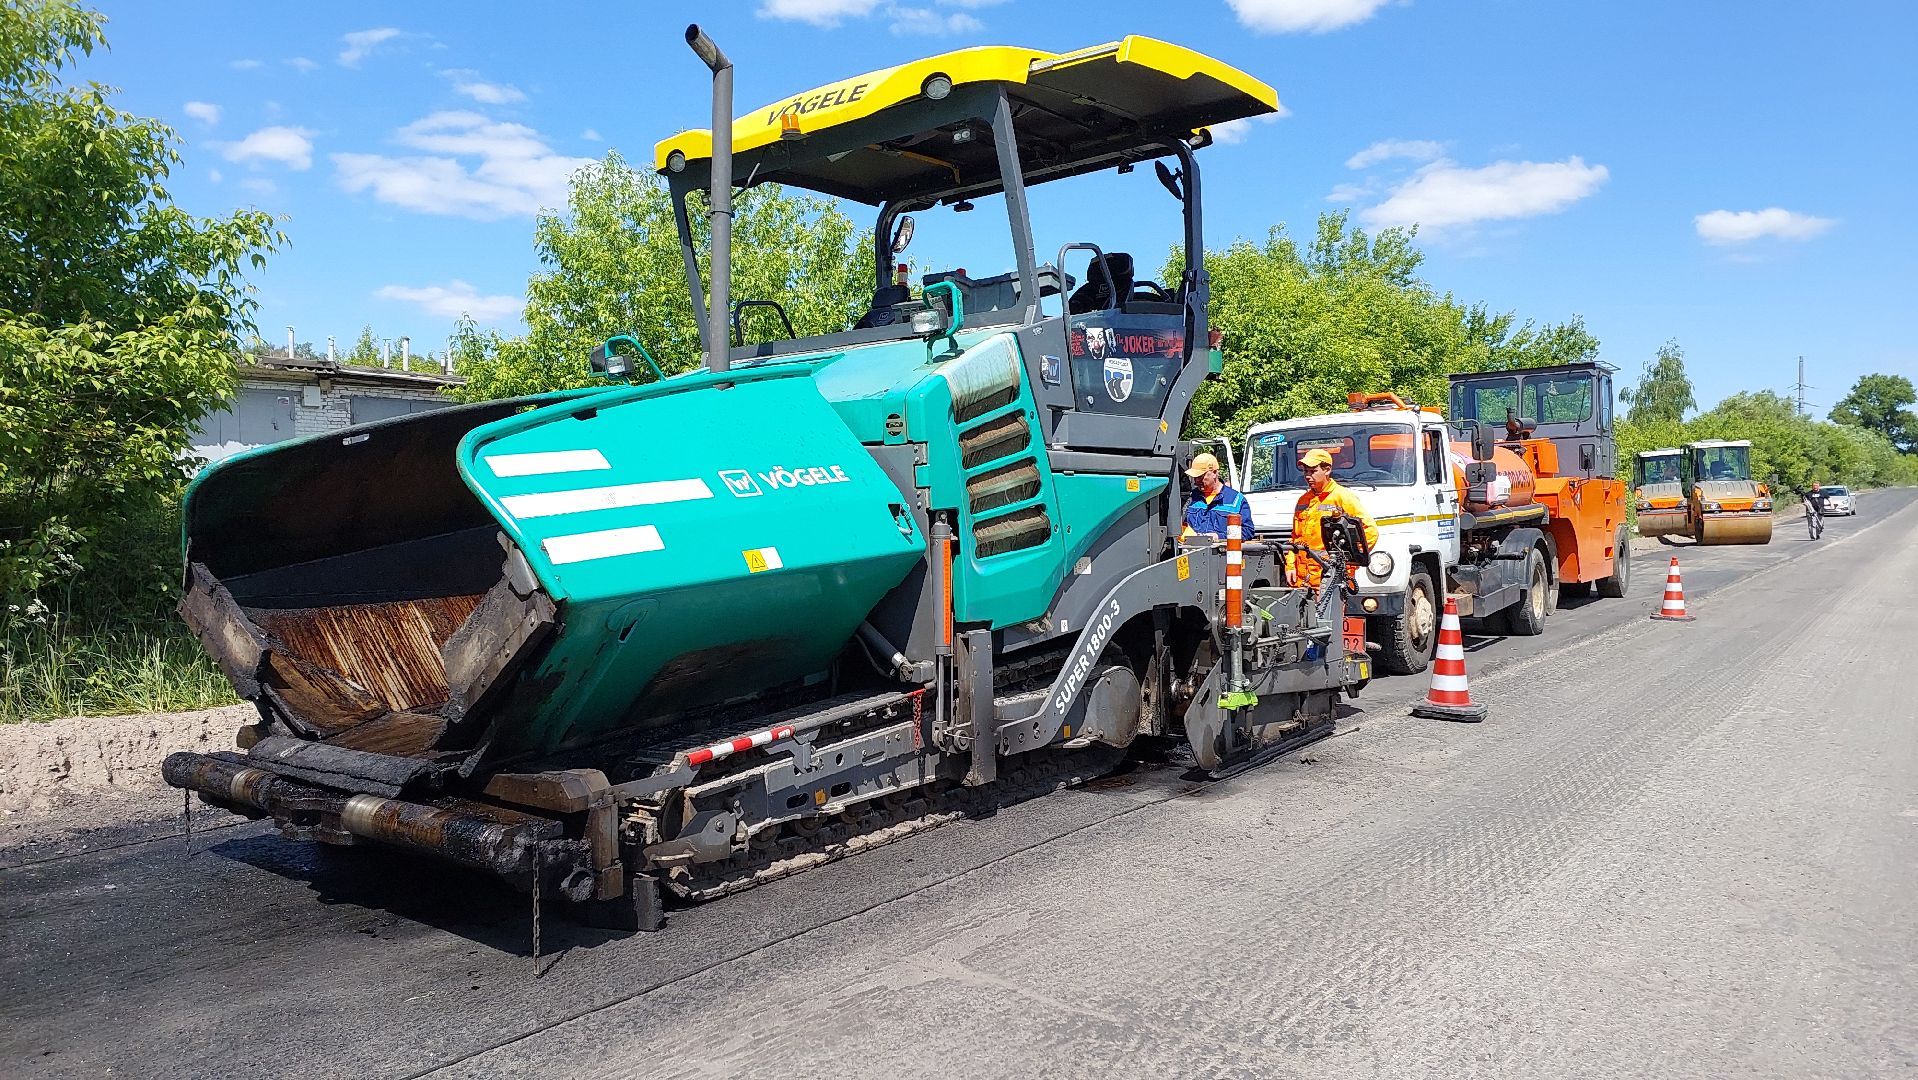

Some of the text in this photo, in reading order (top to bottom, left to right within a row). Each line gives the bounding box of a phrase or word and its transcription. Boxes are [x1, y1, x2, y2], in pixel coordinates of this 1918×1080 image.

[767, 83, 869, 125] VÖGELE
[1123, 335, 1155, 353] JOKER
[757, 465, 851, 490] VÖGELE
[1343, 620, 1349, 632] 0
[1055, 598, 1121, 715] SUPER 1800-3
